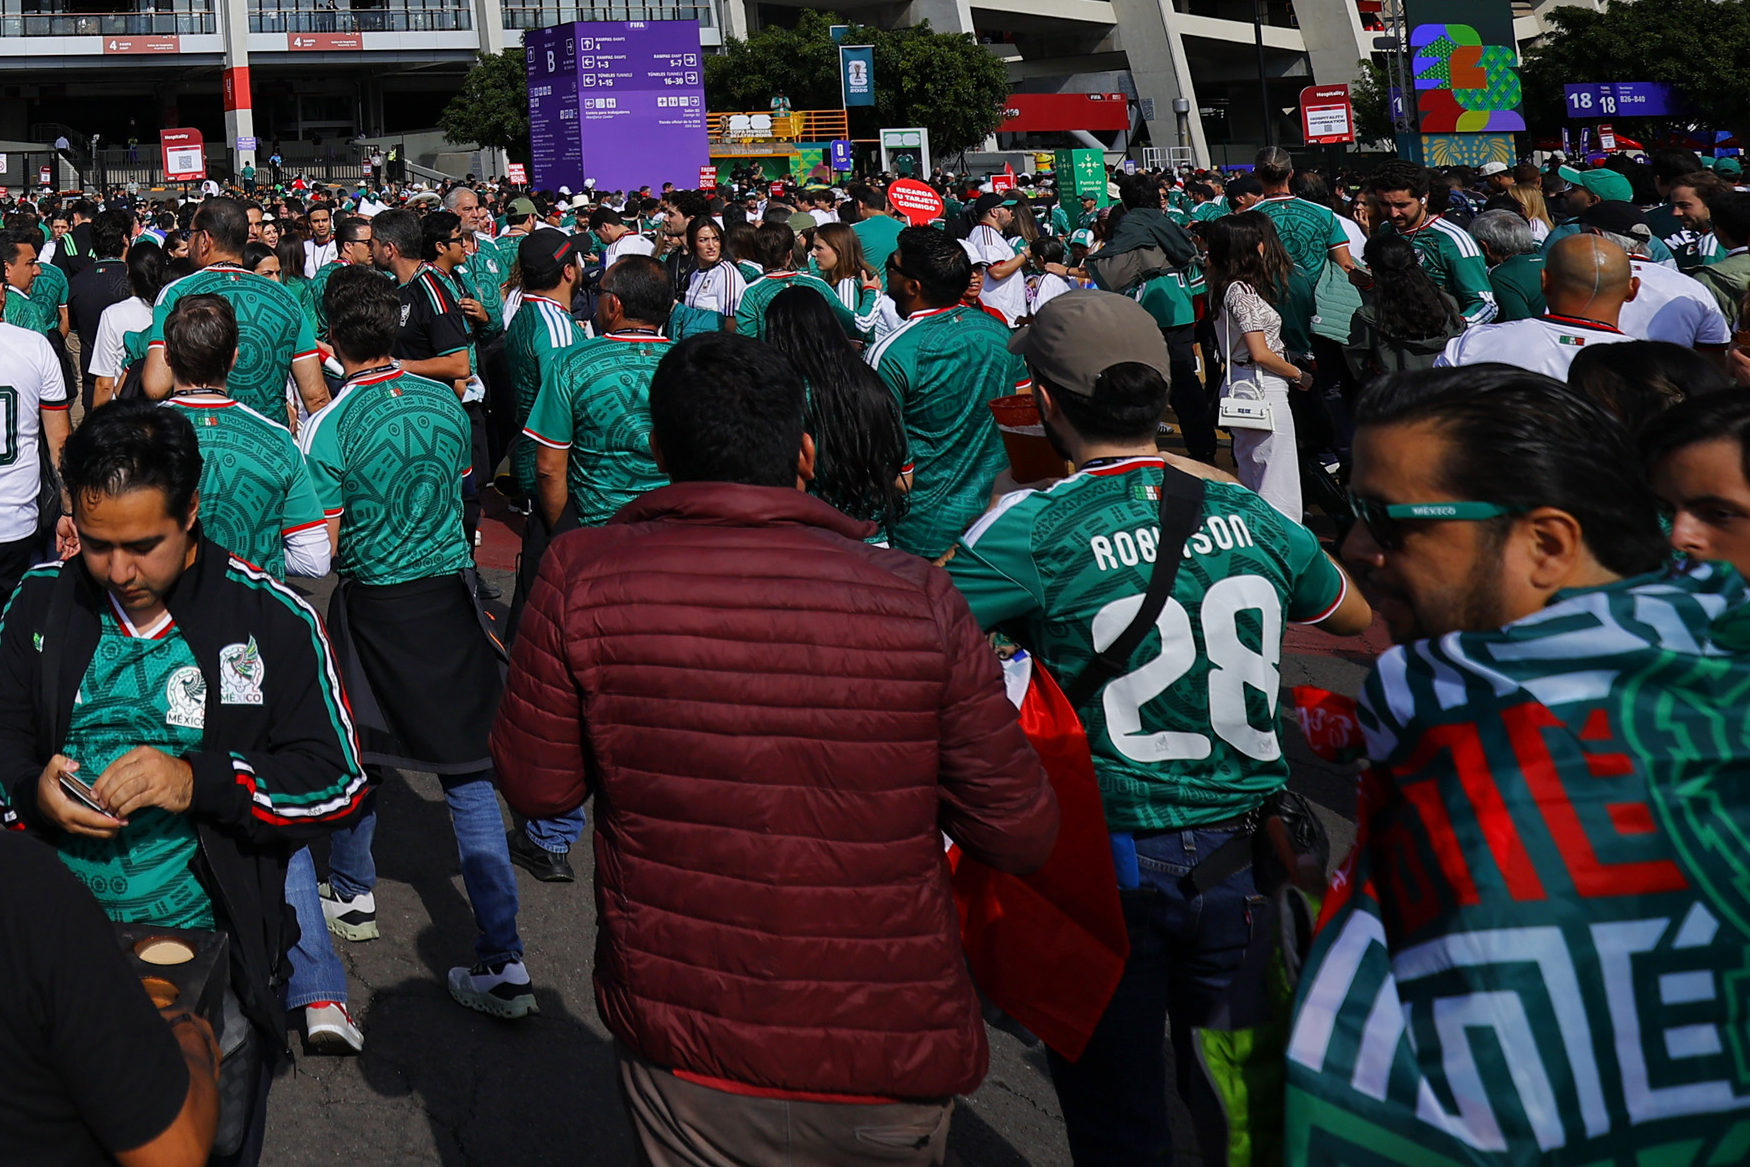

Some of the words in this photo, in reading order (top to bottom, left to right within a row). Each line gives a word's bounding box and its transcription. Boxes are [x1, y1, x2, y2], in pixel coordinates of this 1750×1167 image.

[109, 40, 117, 51] 4
[293, 37, 302, 47] 4
[547, 50, 556, 73] B
[1569, 92, 1592, 109] 18
[1599, 96, 1616, 113] 18
[164, 133, 189, 141] Hospitality
[896, 186, 933, 198] RECARGA
[892, 192, 903, 200] TU
[905, 194, 940, 207] TARJETA
[898, 200, 936, 212] CONMIGO
[1090, 514, 1254, 571] ROBSON
[1090, 574, 1284, 763] 28
[220, 691, 261, 703] MÉXICO
